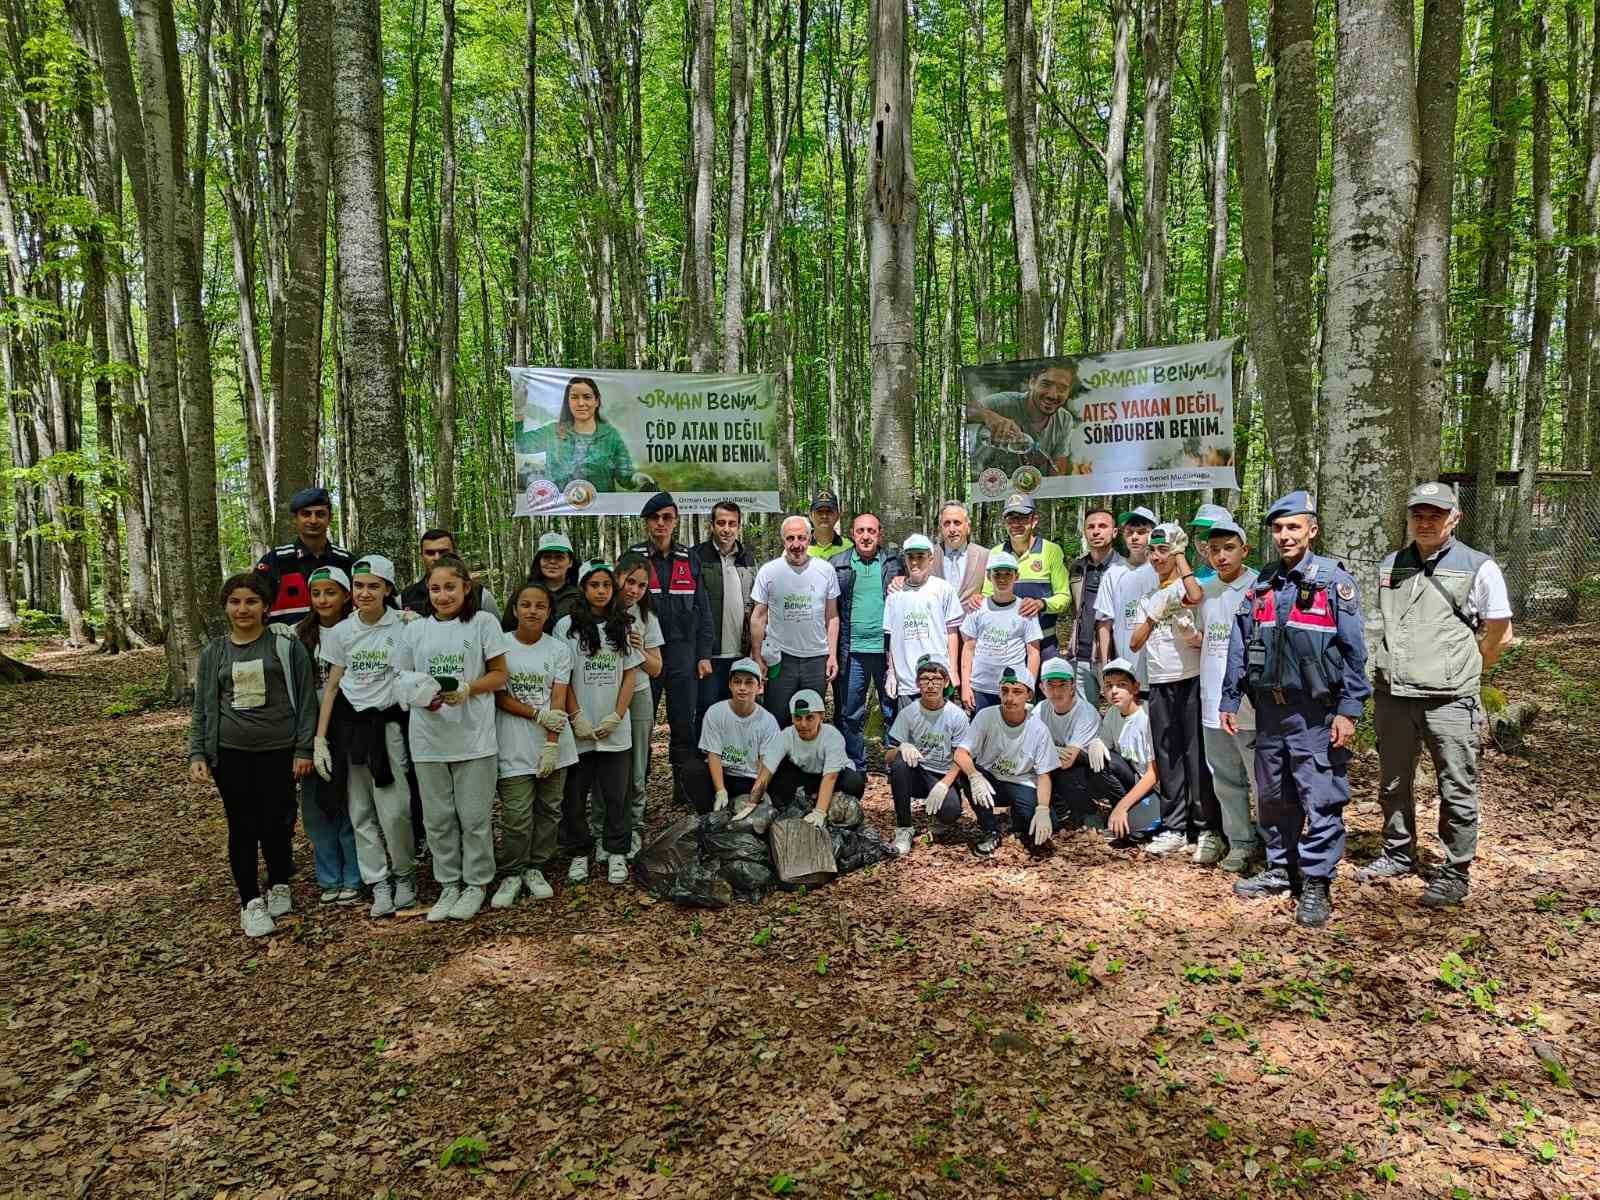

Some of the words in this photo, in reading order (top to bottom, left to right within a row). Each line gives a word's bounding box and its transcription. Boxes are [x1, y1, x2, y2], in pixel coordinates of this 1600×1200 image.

[1086, 366, 1149, 388] ORMAN
[641, 389, 703, 410] ORMAN
[1082, 402, 1118, 422] ATEŞ
[1121, 398, 1171, 419] YAKAN
[645, 419, 677, 443] ÇÖP
[681, 422, 719, 441] ATAN
[1169, 416, 1225, 438] BENİM.
[645, 444, 718, 463] TOPLAYAN
[678, 496, 702, 504] Orman
